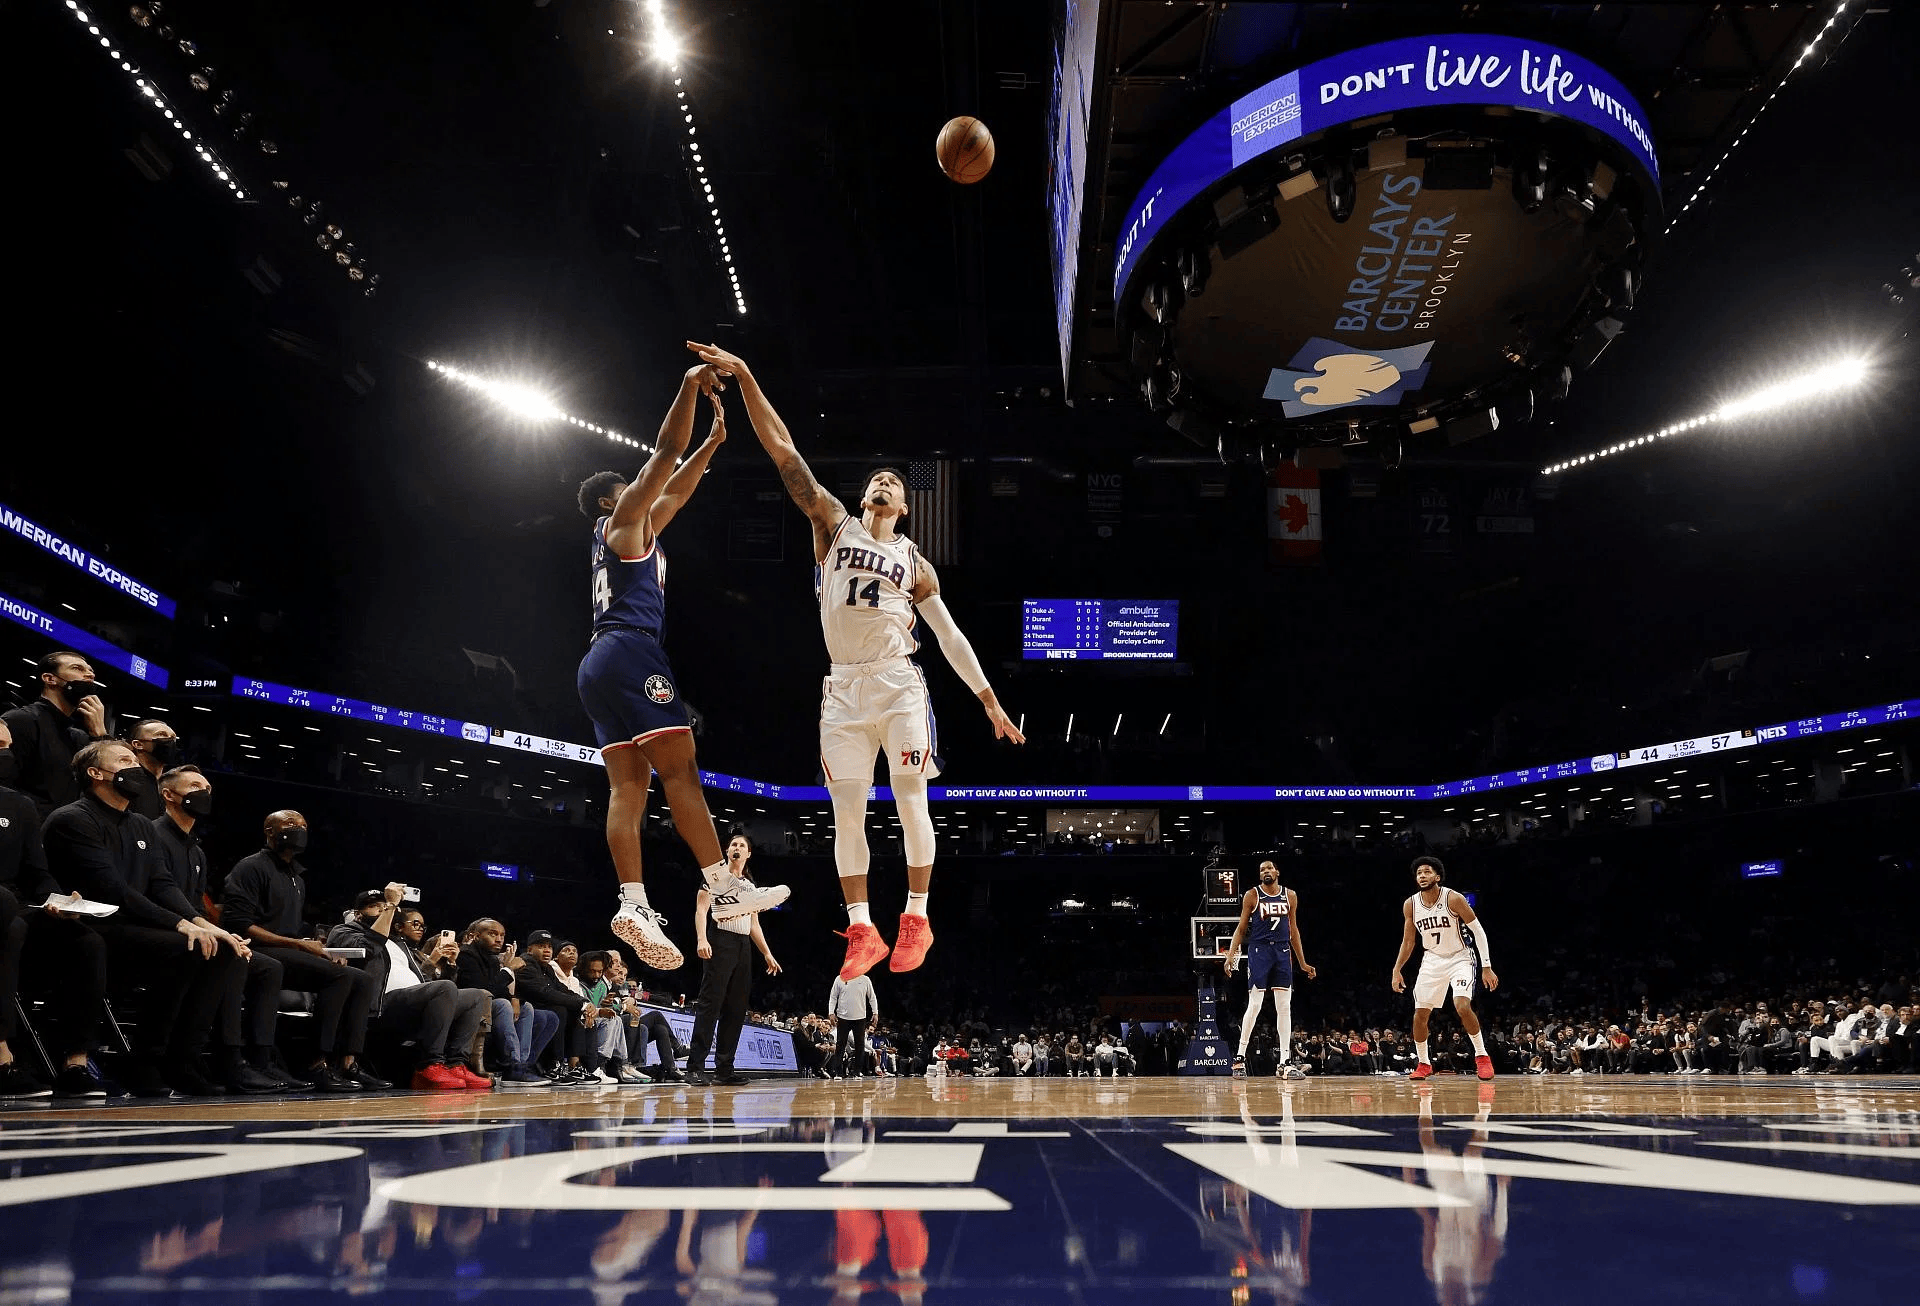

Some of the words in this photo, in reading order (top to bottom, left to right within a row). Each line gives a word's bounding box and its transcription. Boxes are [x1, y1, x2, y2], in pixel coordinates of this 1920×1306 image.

[1320, 64, 1414, 104] DON'T
[1425, 45, 1511, 91] live
[1520, 49, 1583, 104] life
[1587, 84, 1653, 161] WITHOUT
[1232, 93, 1296, 135] AMERICAN
[1243, 105, 1301, 143] EXPRESS
[1333, 173, 1421, 331] BARCLAYS
[1375, 212, 1457, 332] CENTER
[1413, 232, 1473, 330] BROOKLYN
[834, 546, 906, 589] PHILA
[88, 557, 159, 607] EXPRESS
[846, 576, 881, 608] 14
[39, 616, 54, 632] IT.
[1113, 637, 1141, 645] Barclays
[1142, 637, 1165, 645] Center
[1046, 650, 1078, 659] NETS
[251, 681, 263, 689] FG
[292, 689, 308, 698] 3PT
[335, 698, 346, 706] FT
[1887, 703, 1903, 712] 3PT
[371, 704, 388, 714] REB
[398, 710, 414, 719] AST
[1847, 711, 1859, 719] FG
[422, 723, 439, 732] TOL:
[1757, 726, 1787, 744] NETS
[513, 735, 532, 749] 44
[545, 740, 566, 752] 1:52
[1673, 740, 1695, 752] 1:52
[1711, 735, 1731, 749] 57
[578, 748, 596, 761] 57
[901, 750, 921, 766] 76
[1640, 748, 1659, 761] 44
[946, 789, 974, 797] DON'T
[975, 789, 997, 797] GIVE
[998, 789, 1018, 797] AND
[1019, 789, 1034, 797] GO
[1034, 789, 1075, 797] WITHOUT
[1077, 789, 1088, 797] IT.
[1275, 789, 1304, 797] DON'T
[1304, 789, 1326, 797] GIVE
[1327, 789, 1346, 797] AND
[1347, 789, 1362, 797] GO
[1362, 789, 1404, 797] WITHOUT
[1406, 789, 1416, 797] IT.
[1223, 880, 1233, 895] 7
[1259, 902, 1288, 918] NETS
[1270, 916, 1281, 931] 7
[1415, 916, 1451, 933] PHILA
[1431, 932, 1441, 945] 7
[1456, 979, 1467, 987] 76
[1194, 1058, 1228, 1066] BARCLAYS
